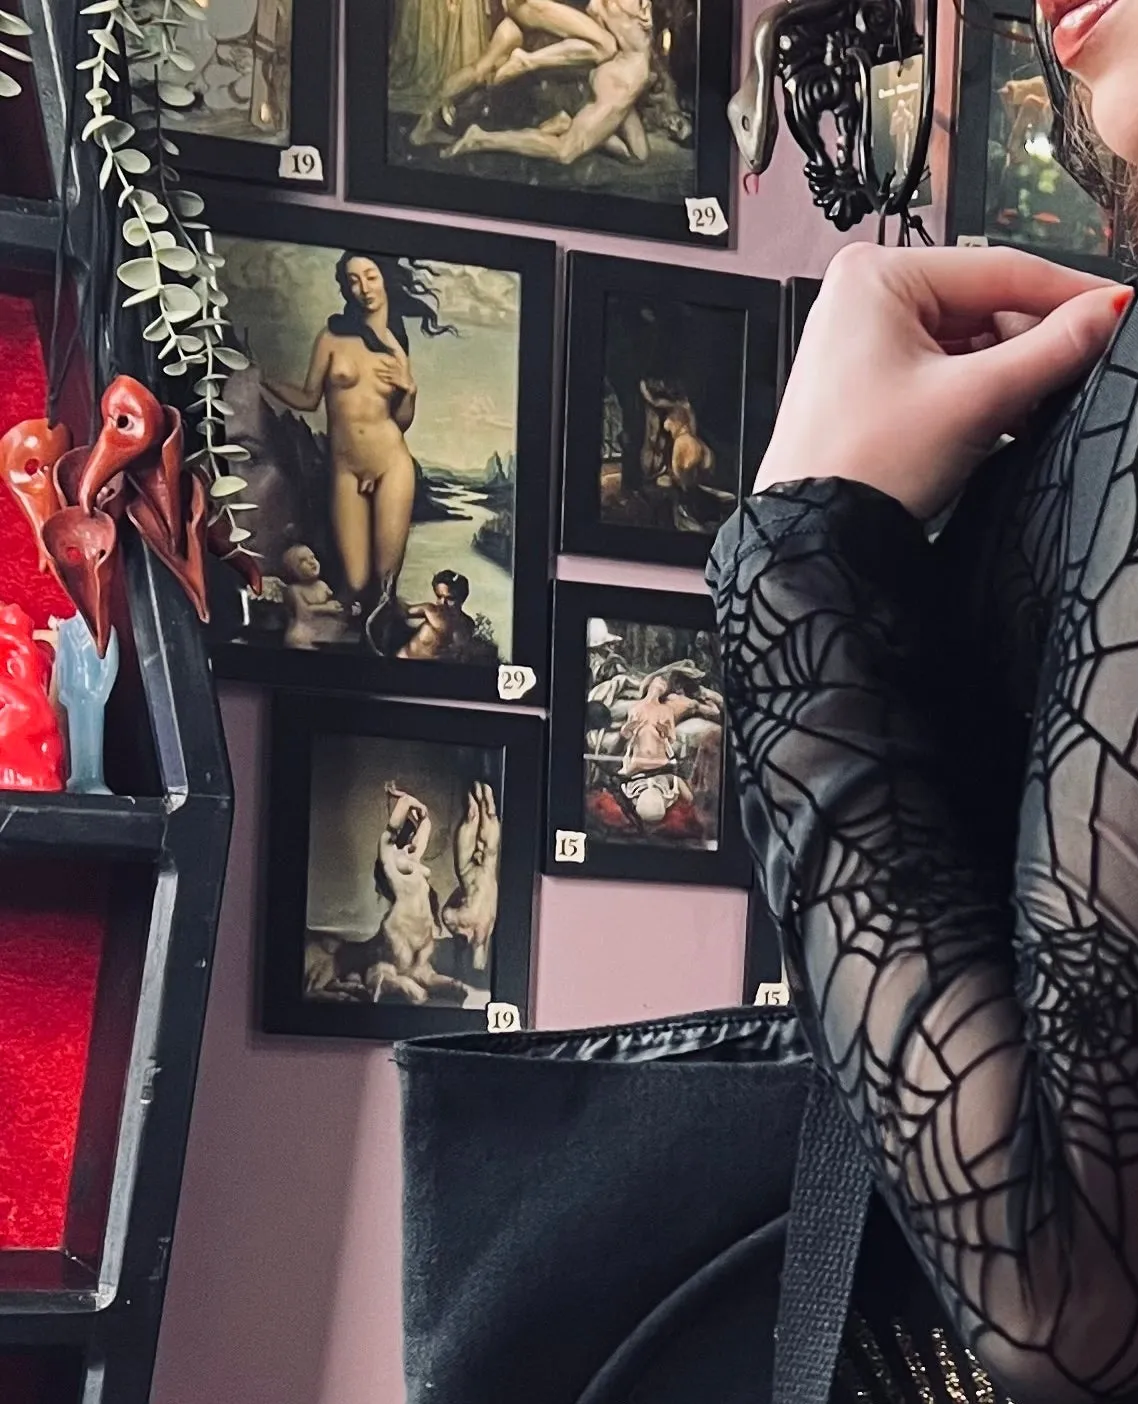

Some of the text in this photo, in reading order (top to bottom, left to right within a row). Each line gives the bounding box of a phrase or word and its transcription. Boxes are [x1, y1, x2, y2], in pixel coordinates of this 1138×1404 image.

[292, 153, 315, 174] 19
[692, 206, 716, 227] 29
[502, 670, 526, 690] 29
[559, 838, 578, 857] 15
[764, 990, 780, 1005] 15
[492, 1011, 514, 1029] 19
